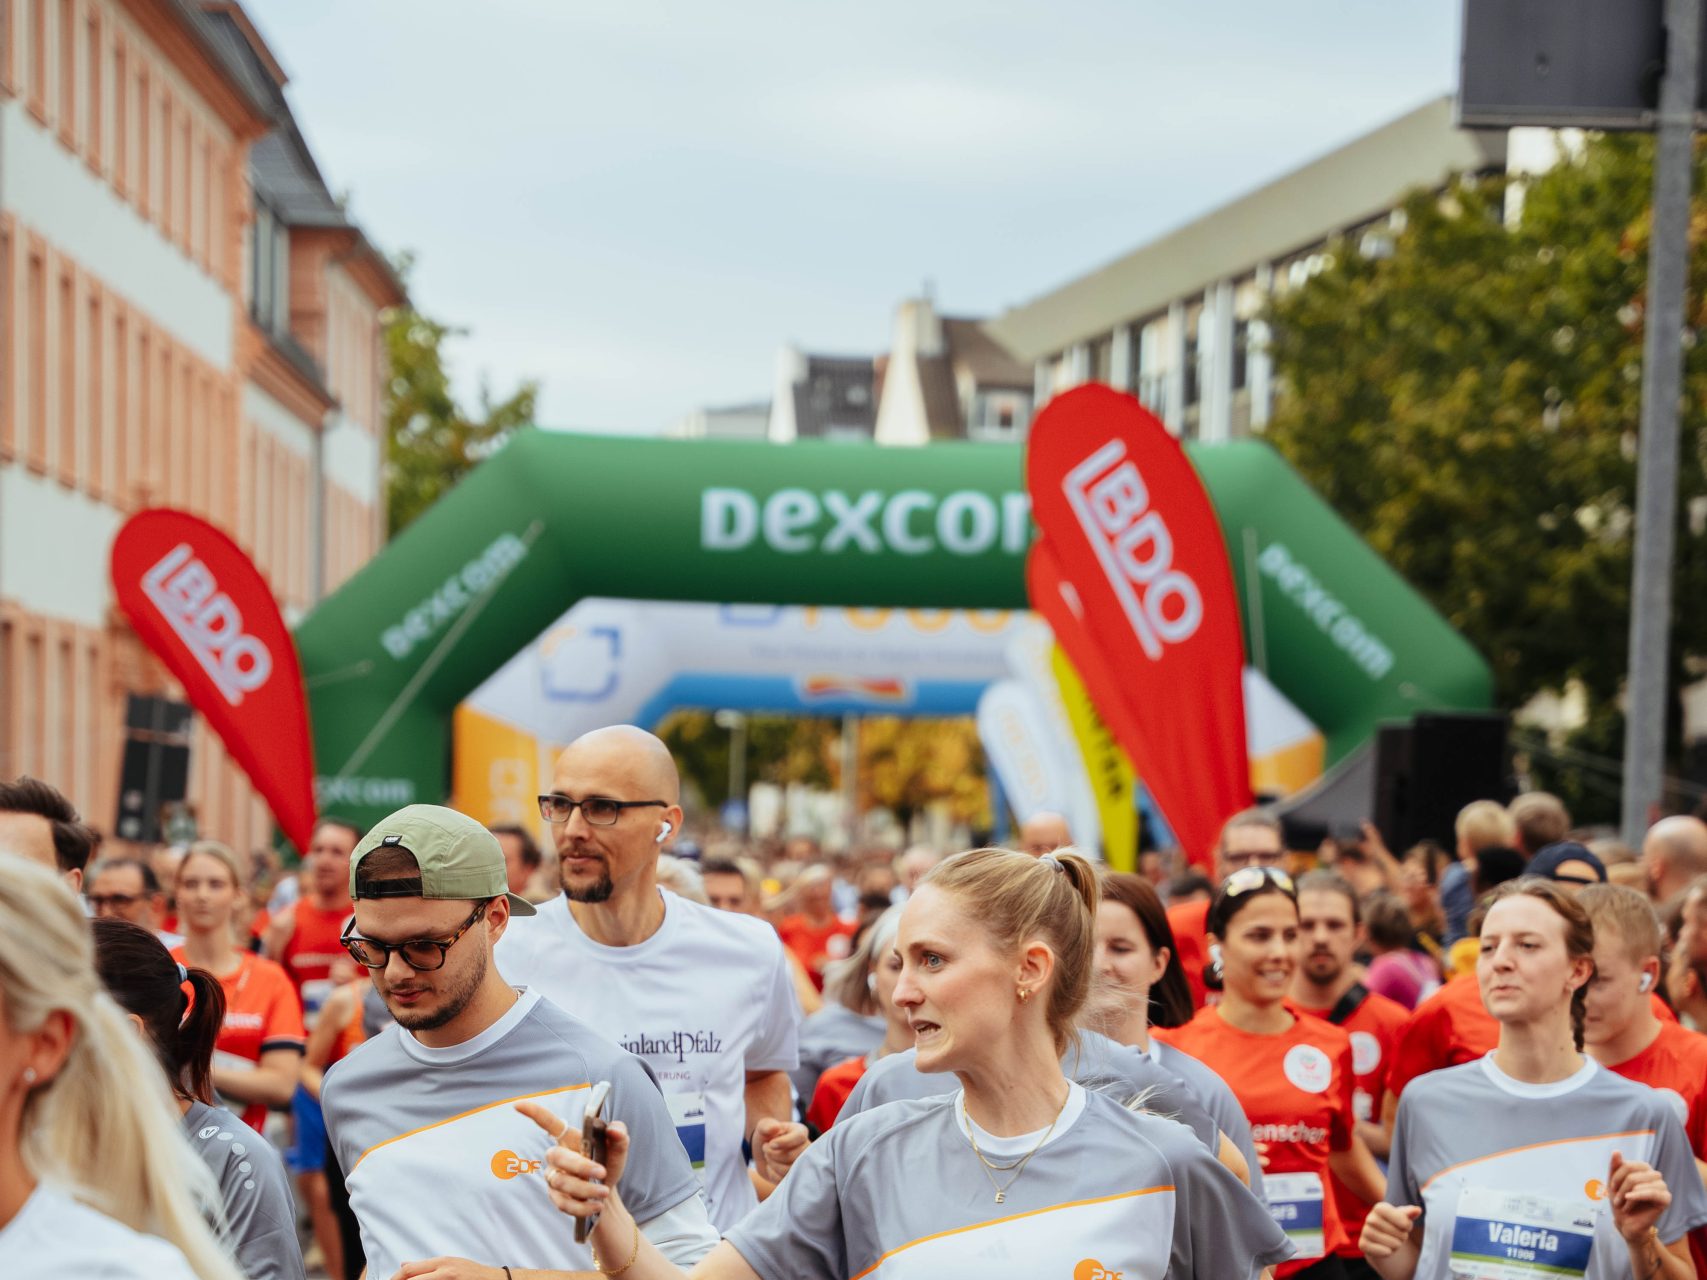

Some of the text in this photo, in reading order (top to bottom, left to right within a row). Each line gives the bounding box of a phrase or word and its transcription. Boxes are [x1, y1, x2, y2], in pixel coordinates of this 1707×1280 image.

[1087, 460, 1204, 644] BDO
[165, 558, 274, 693] BDO
[620, 1031, 722, 1063] inlandPfalz
[1270, 1204, 1297, 1221] ara
[1489, 1222, 1558, 1252] Valeria
